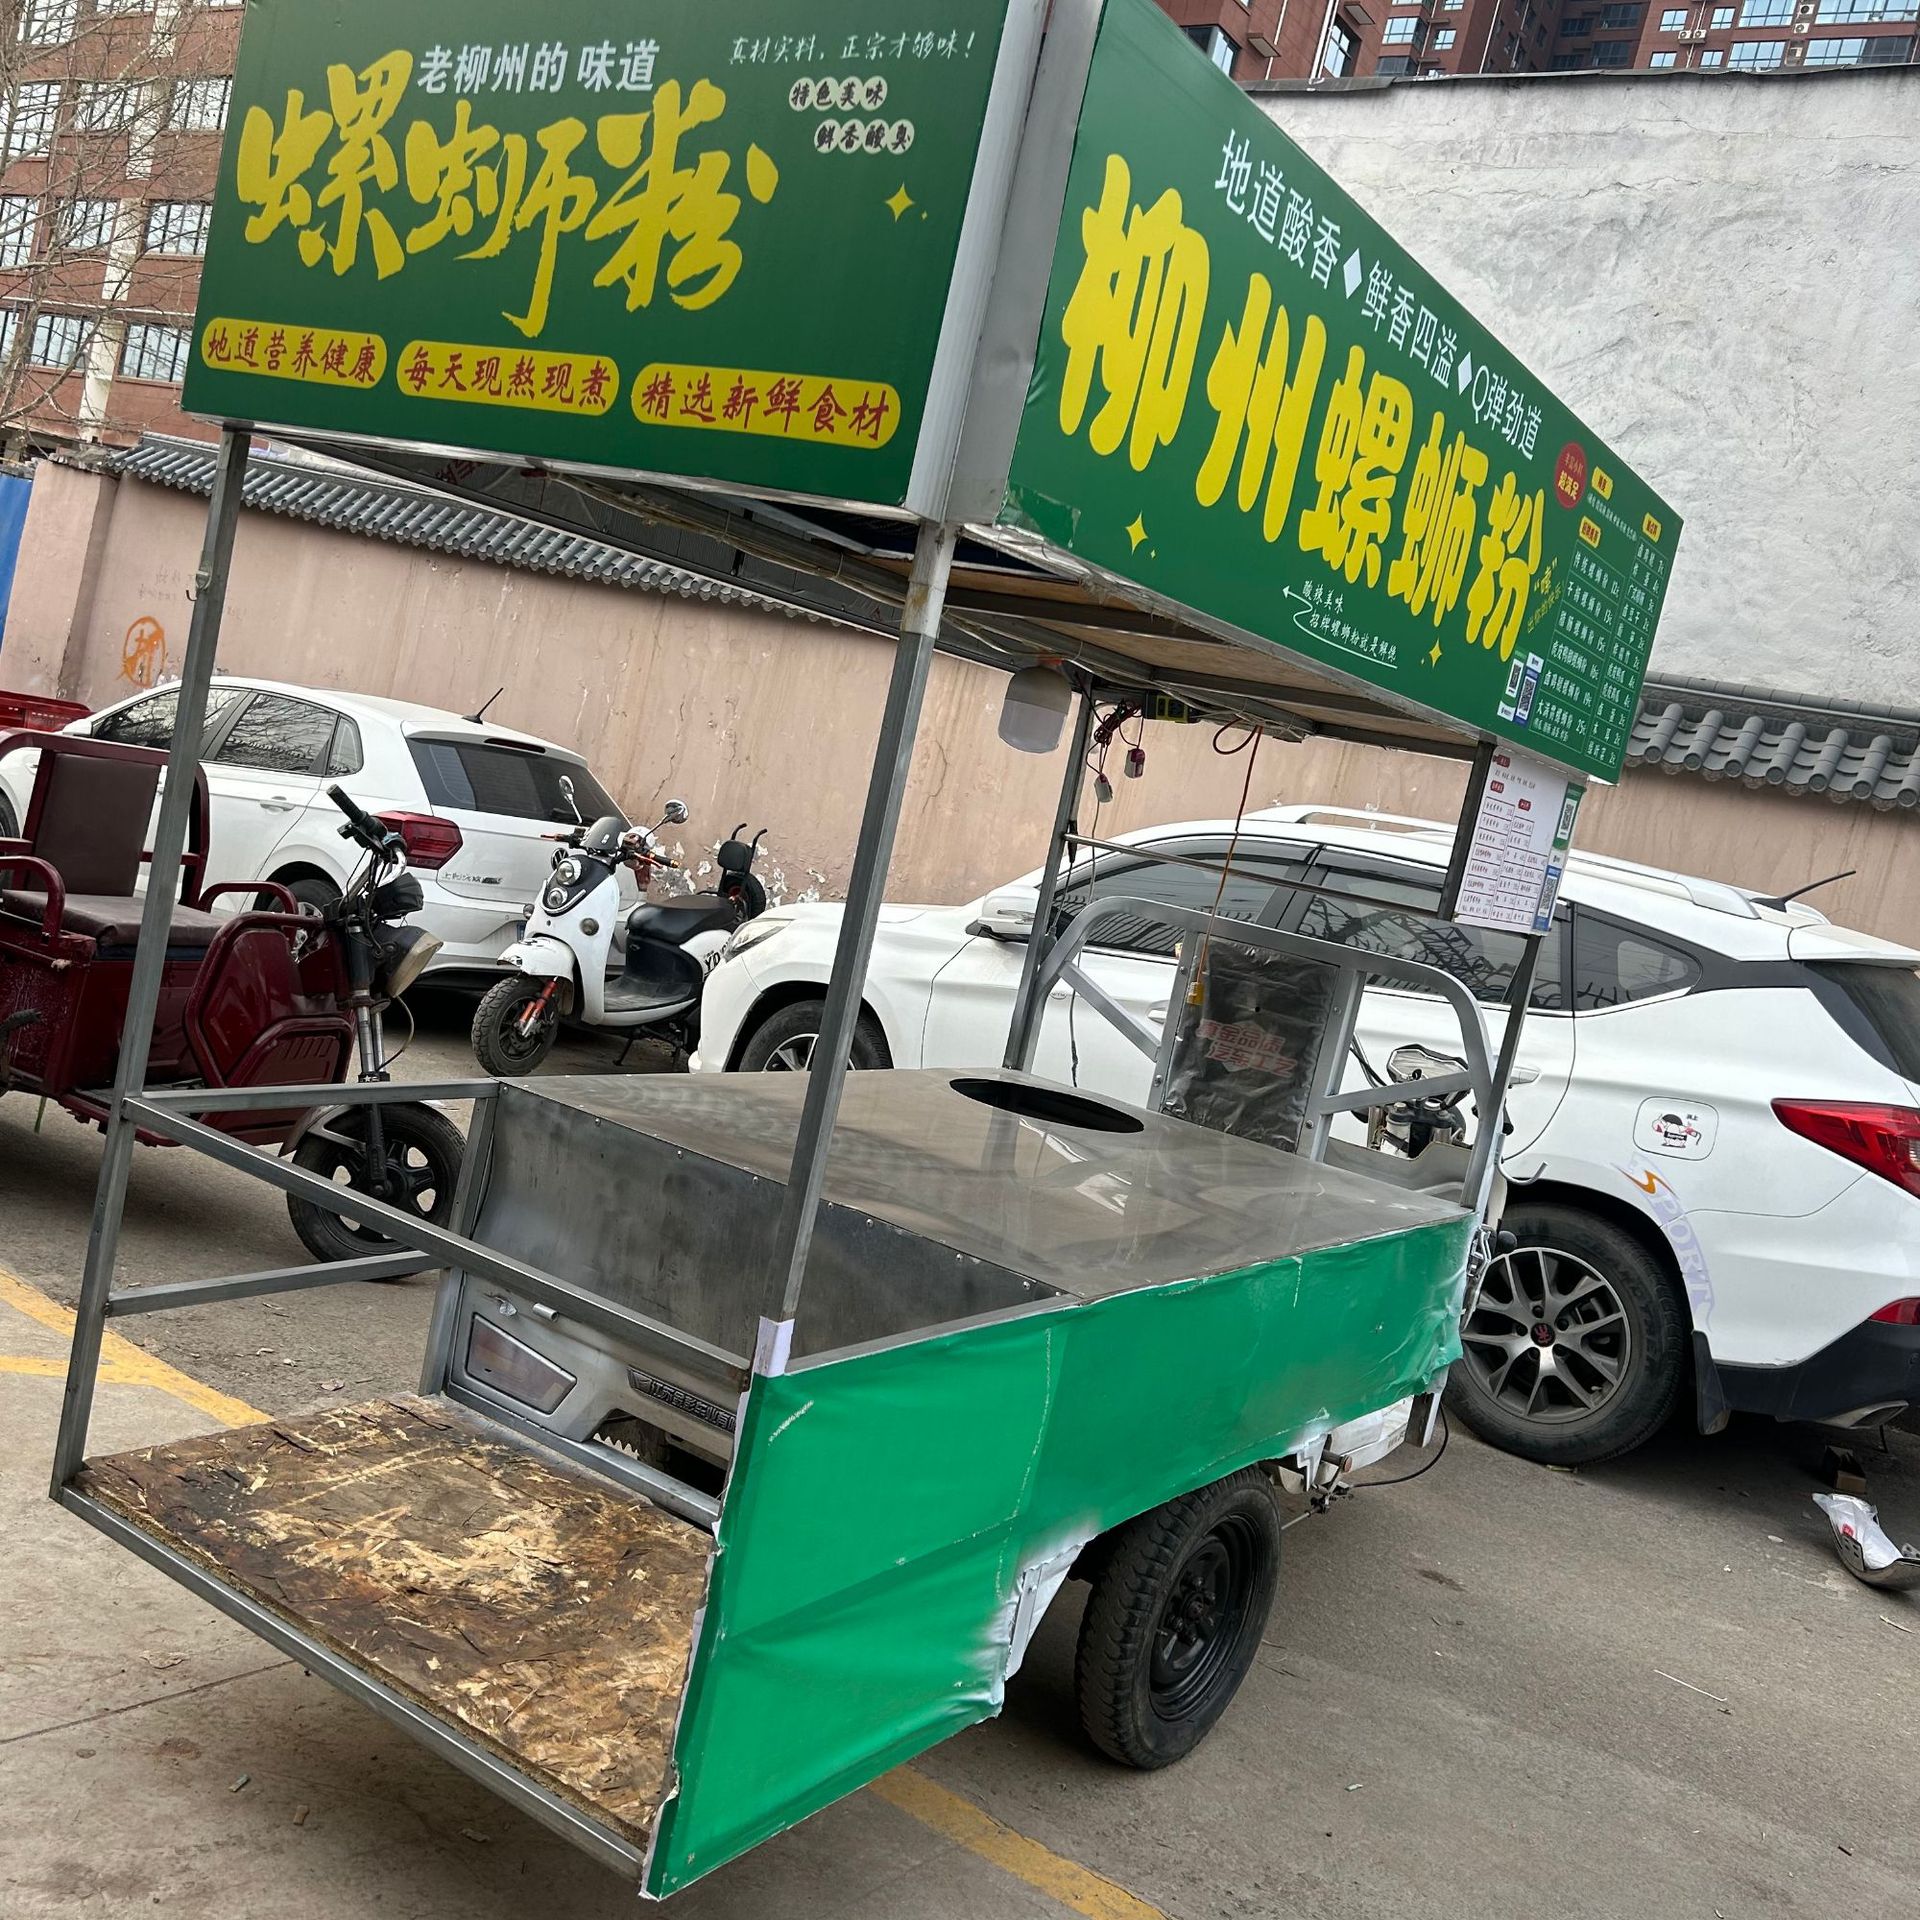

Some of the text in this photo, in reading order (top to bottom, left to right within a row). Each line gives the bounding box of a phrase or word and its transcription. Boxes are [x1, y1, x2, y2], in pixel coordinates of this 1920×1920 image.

[791, 81, 885, 108] 特色美味
[816, 123, 911, 149] 鲜香酸臭
[235, 50, 779, 338] 螺蛳粉
[1214, 128, 1543, 461] 地道酸香 鲜香四溢 Q弹劲道
[205, 327, 380, 384] 地道营养健康
[404, 348, 611, 409] 每天现熬现煮
[641, 371, 892, 441] 精选新鲜食材
[1059, 153, 1545, 662] 柳州螺蛳粉
[1302, 580, 1344, 614] 酸辣美味
